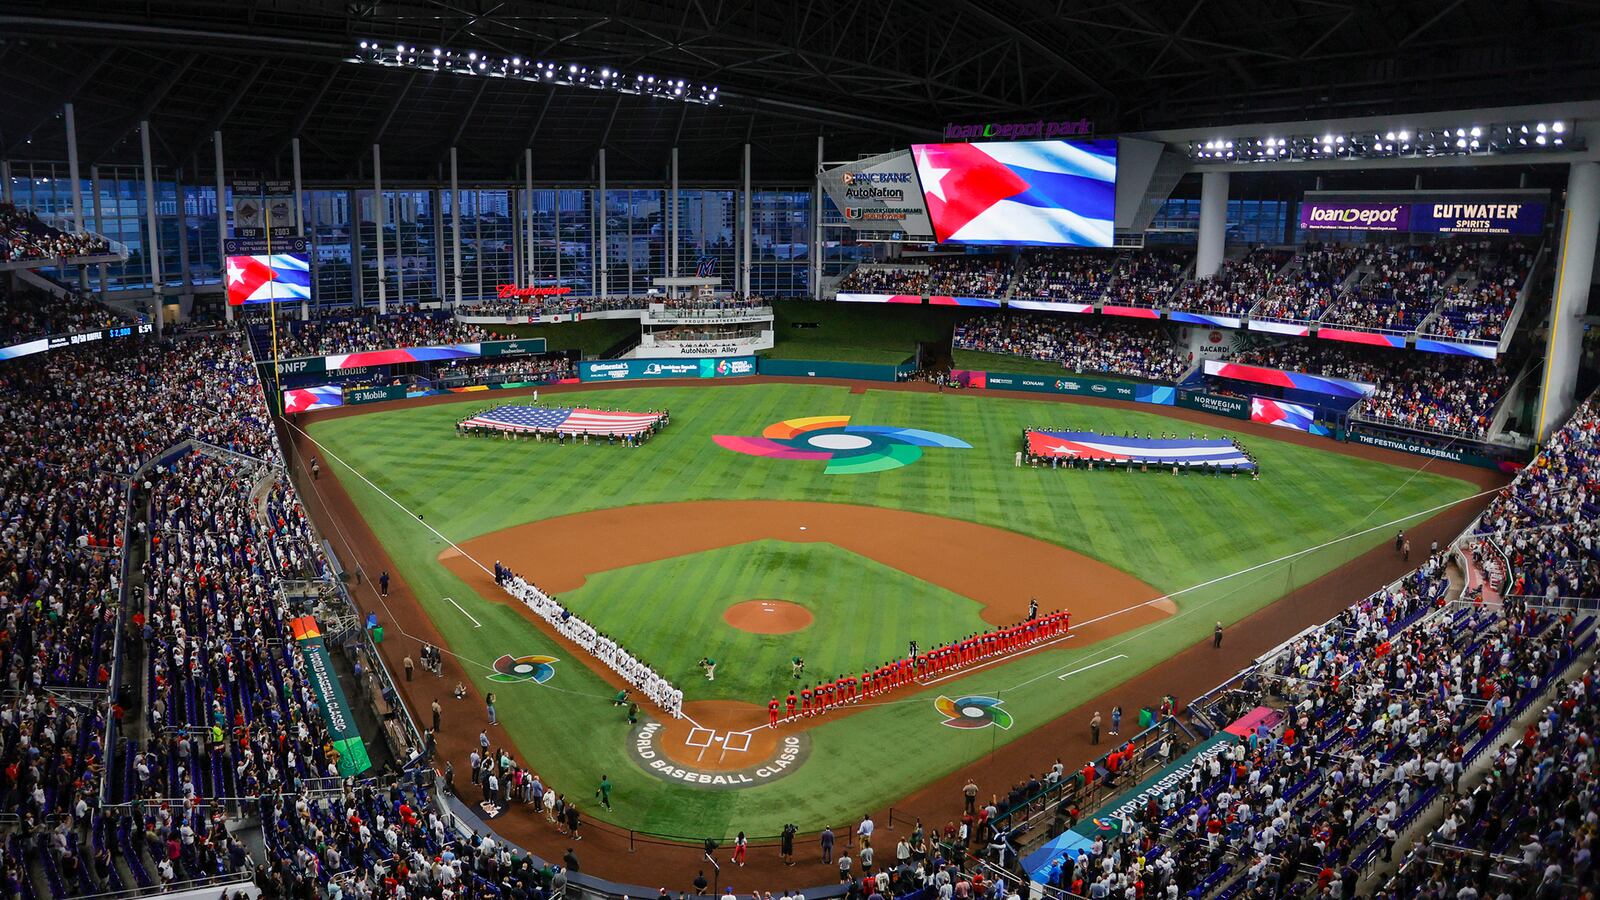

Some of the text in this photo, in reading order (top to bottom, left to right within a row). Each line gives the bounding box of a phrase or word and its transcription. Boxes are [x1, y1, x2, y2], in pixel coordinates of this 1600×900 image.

[945, 118, 1089, 140] loanDepot park
[846, 187, 902, 197] AutoNation
[1310, 206, 1399, 225] loanDepot
[1433, 204, 1518, 219] CUTWATER
[1456, 220, 1490, 228] SPIRITS
[242, 229, 256, 237] 1997
[274, 228, 290, 236] 2003
[891, 232, 900, 240] 42
[496, 284, 572, 299] Budweiser
[680, 346, 738, 355] AutoNation Alley
[284, 361, 307, 373] NFP
[363, 390, 387, 400] Mobile
[1194, 395, 1241, 411] NORWEGIAN
[1360, 435, 1373, 444] THE
[1374, 439, 1408, 451] FESTIVAL
[1420, 446, 1461, 461] BASEBALL
[637, 722, 800, 785] WORLD BASEBALL CLASSIC
